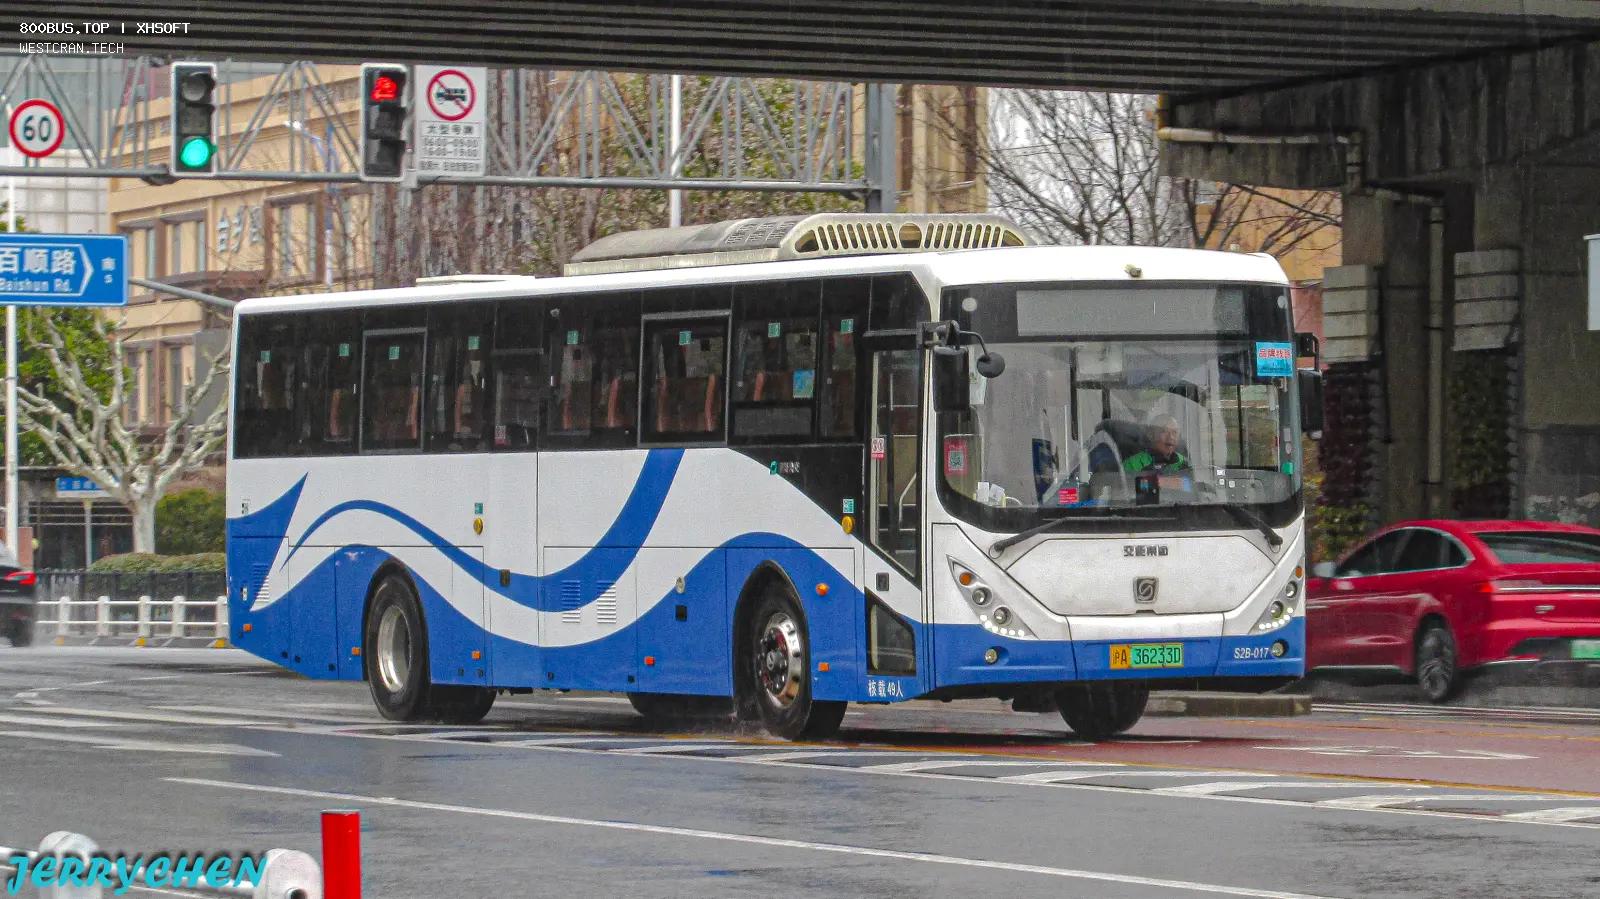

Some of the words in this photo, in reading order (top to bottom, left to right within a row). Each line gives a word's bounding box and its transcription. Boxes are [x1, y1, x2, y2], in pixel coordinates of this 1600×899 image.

[23, 114, 52, 142] 60
[0, 247, 76, 275] 百顺路
[54, 277, 72, 292] Rd.
[103, 274, 113, 284] S
[1234, 647, 1269, 659] S2B-017
